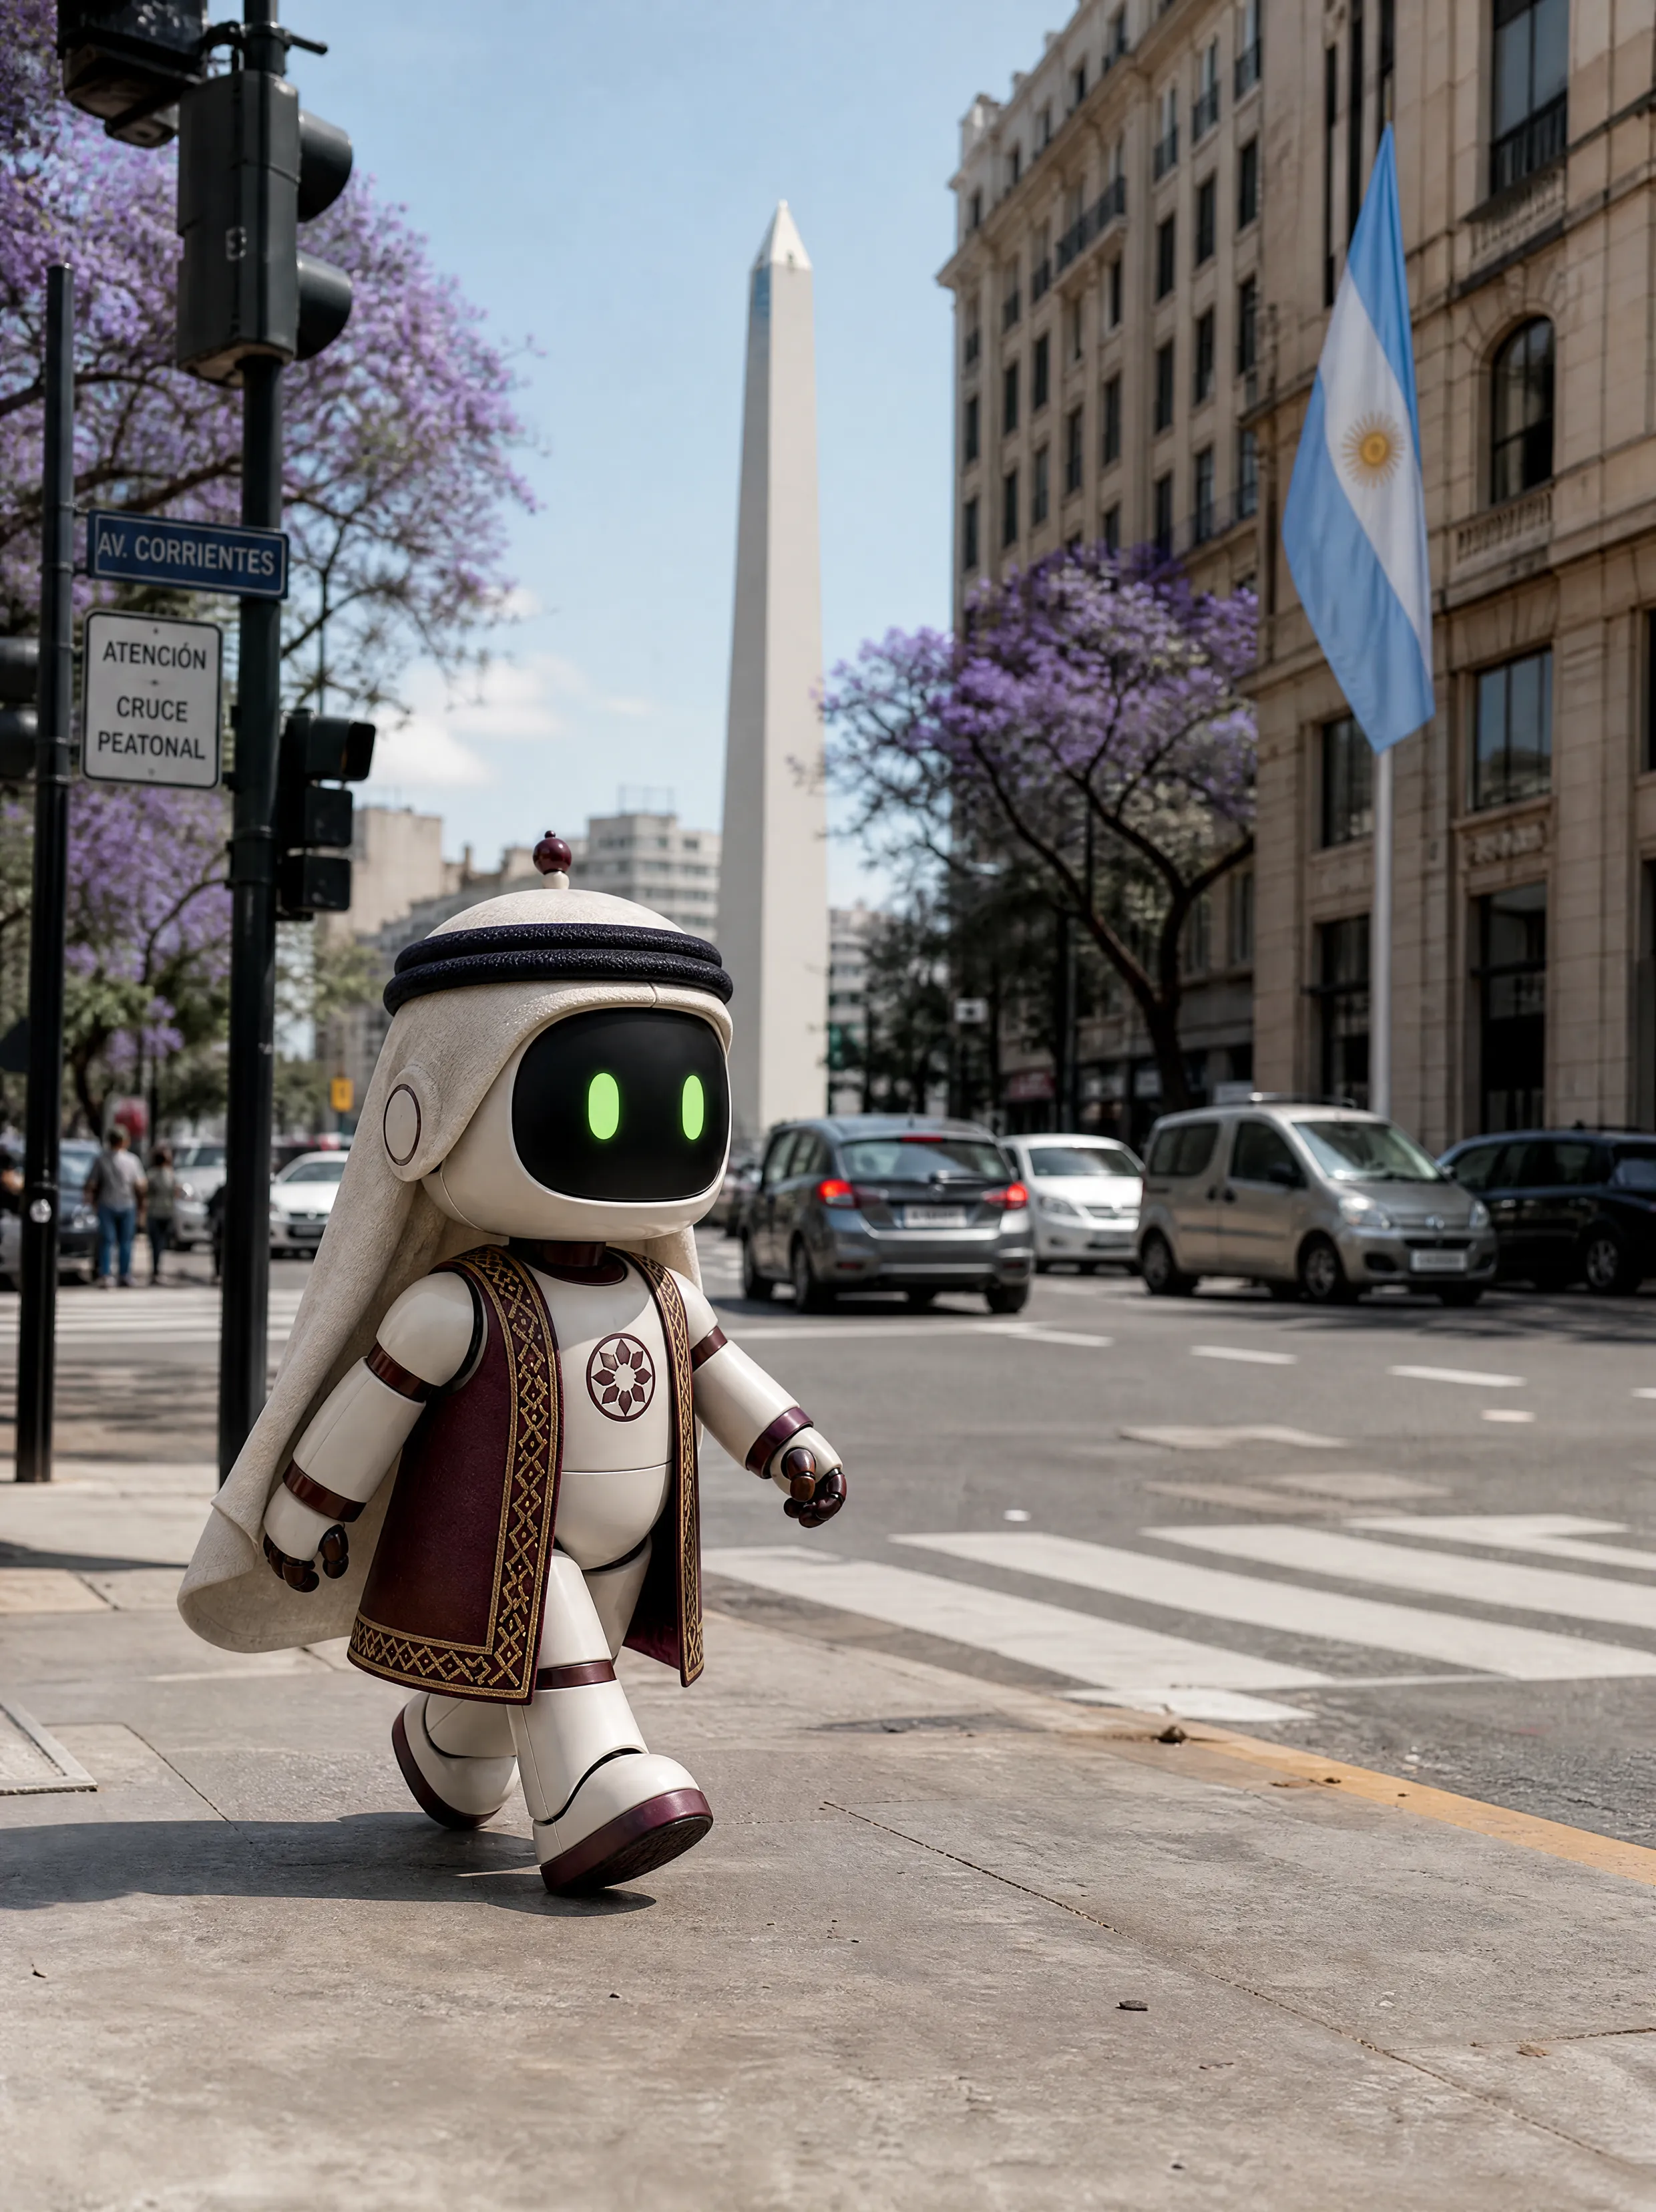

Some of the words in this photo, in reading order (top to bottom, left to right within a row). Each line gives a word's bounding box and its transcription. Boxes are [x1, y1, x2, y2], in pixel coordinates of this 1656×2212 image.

[97, 532, 127, 558] AV.
[135, 535, 275, 576] CORRIENTES
[102, 640, 206, 669] ATENCIÓN
[117, 695, 188, 722] CRUCE
[98, 731, 206, 760] PEATONAL
